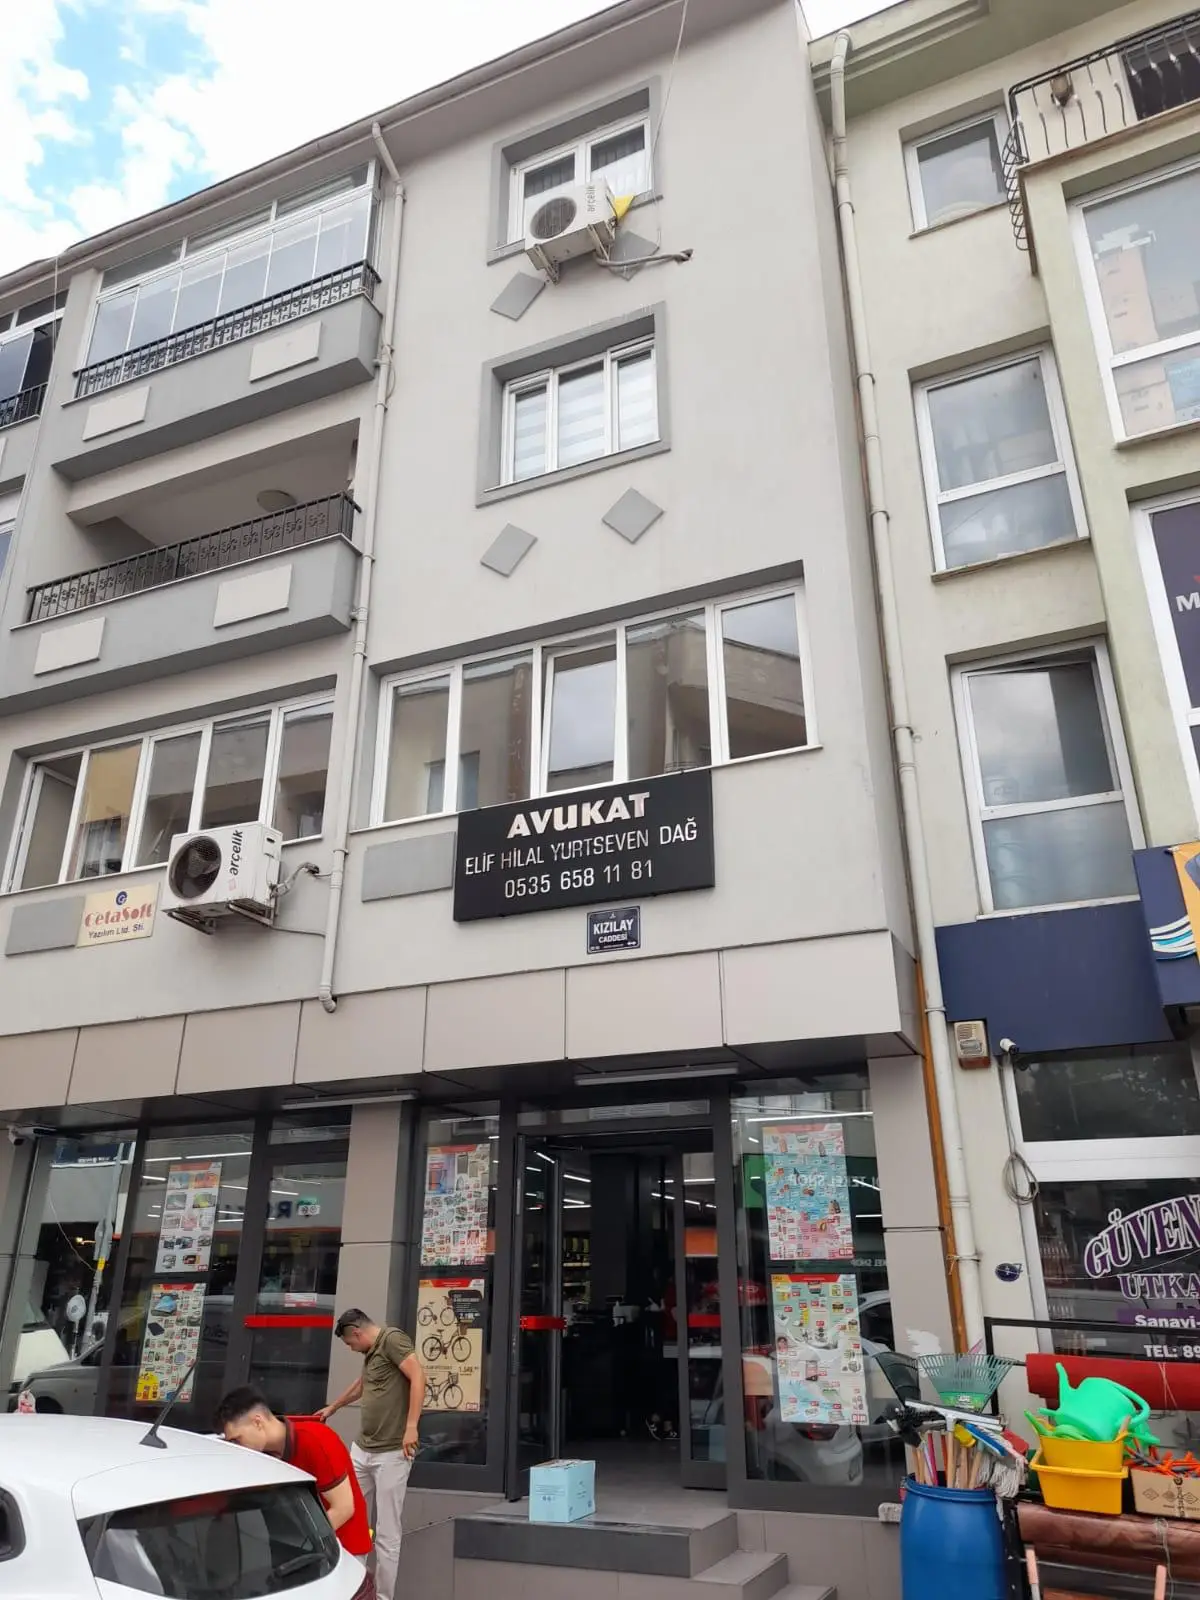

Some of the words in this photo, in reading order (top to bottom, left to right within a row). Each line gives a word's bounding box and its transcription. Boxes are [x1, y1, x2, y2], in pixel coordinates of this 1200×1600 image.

[507, 791, 650, 838] AVUKAT
[229, 829, 243, 876] arçelik
[465, 852, 496, 875] ELİF
[501, 846, 545, 870] HİLAL
[550, 829, 649, 861] YURTSEVEN
[660, 816, 698, 845] DAĞ
[505, 874, 551, 898] 0535
[560, 867, 595, 890] 658
[603, 863, 620, 884] 11
[631, 859, 652, 880] 81
[593, 918, 634, 935] KIZILAY
[598, 932, 628, 944] CADDESİ
[1143, 1344, 1178, 1358] TEL:
